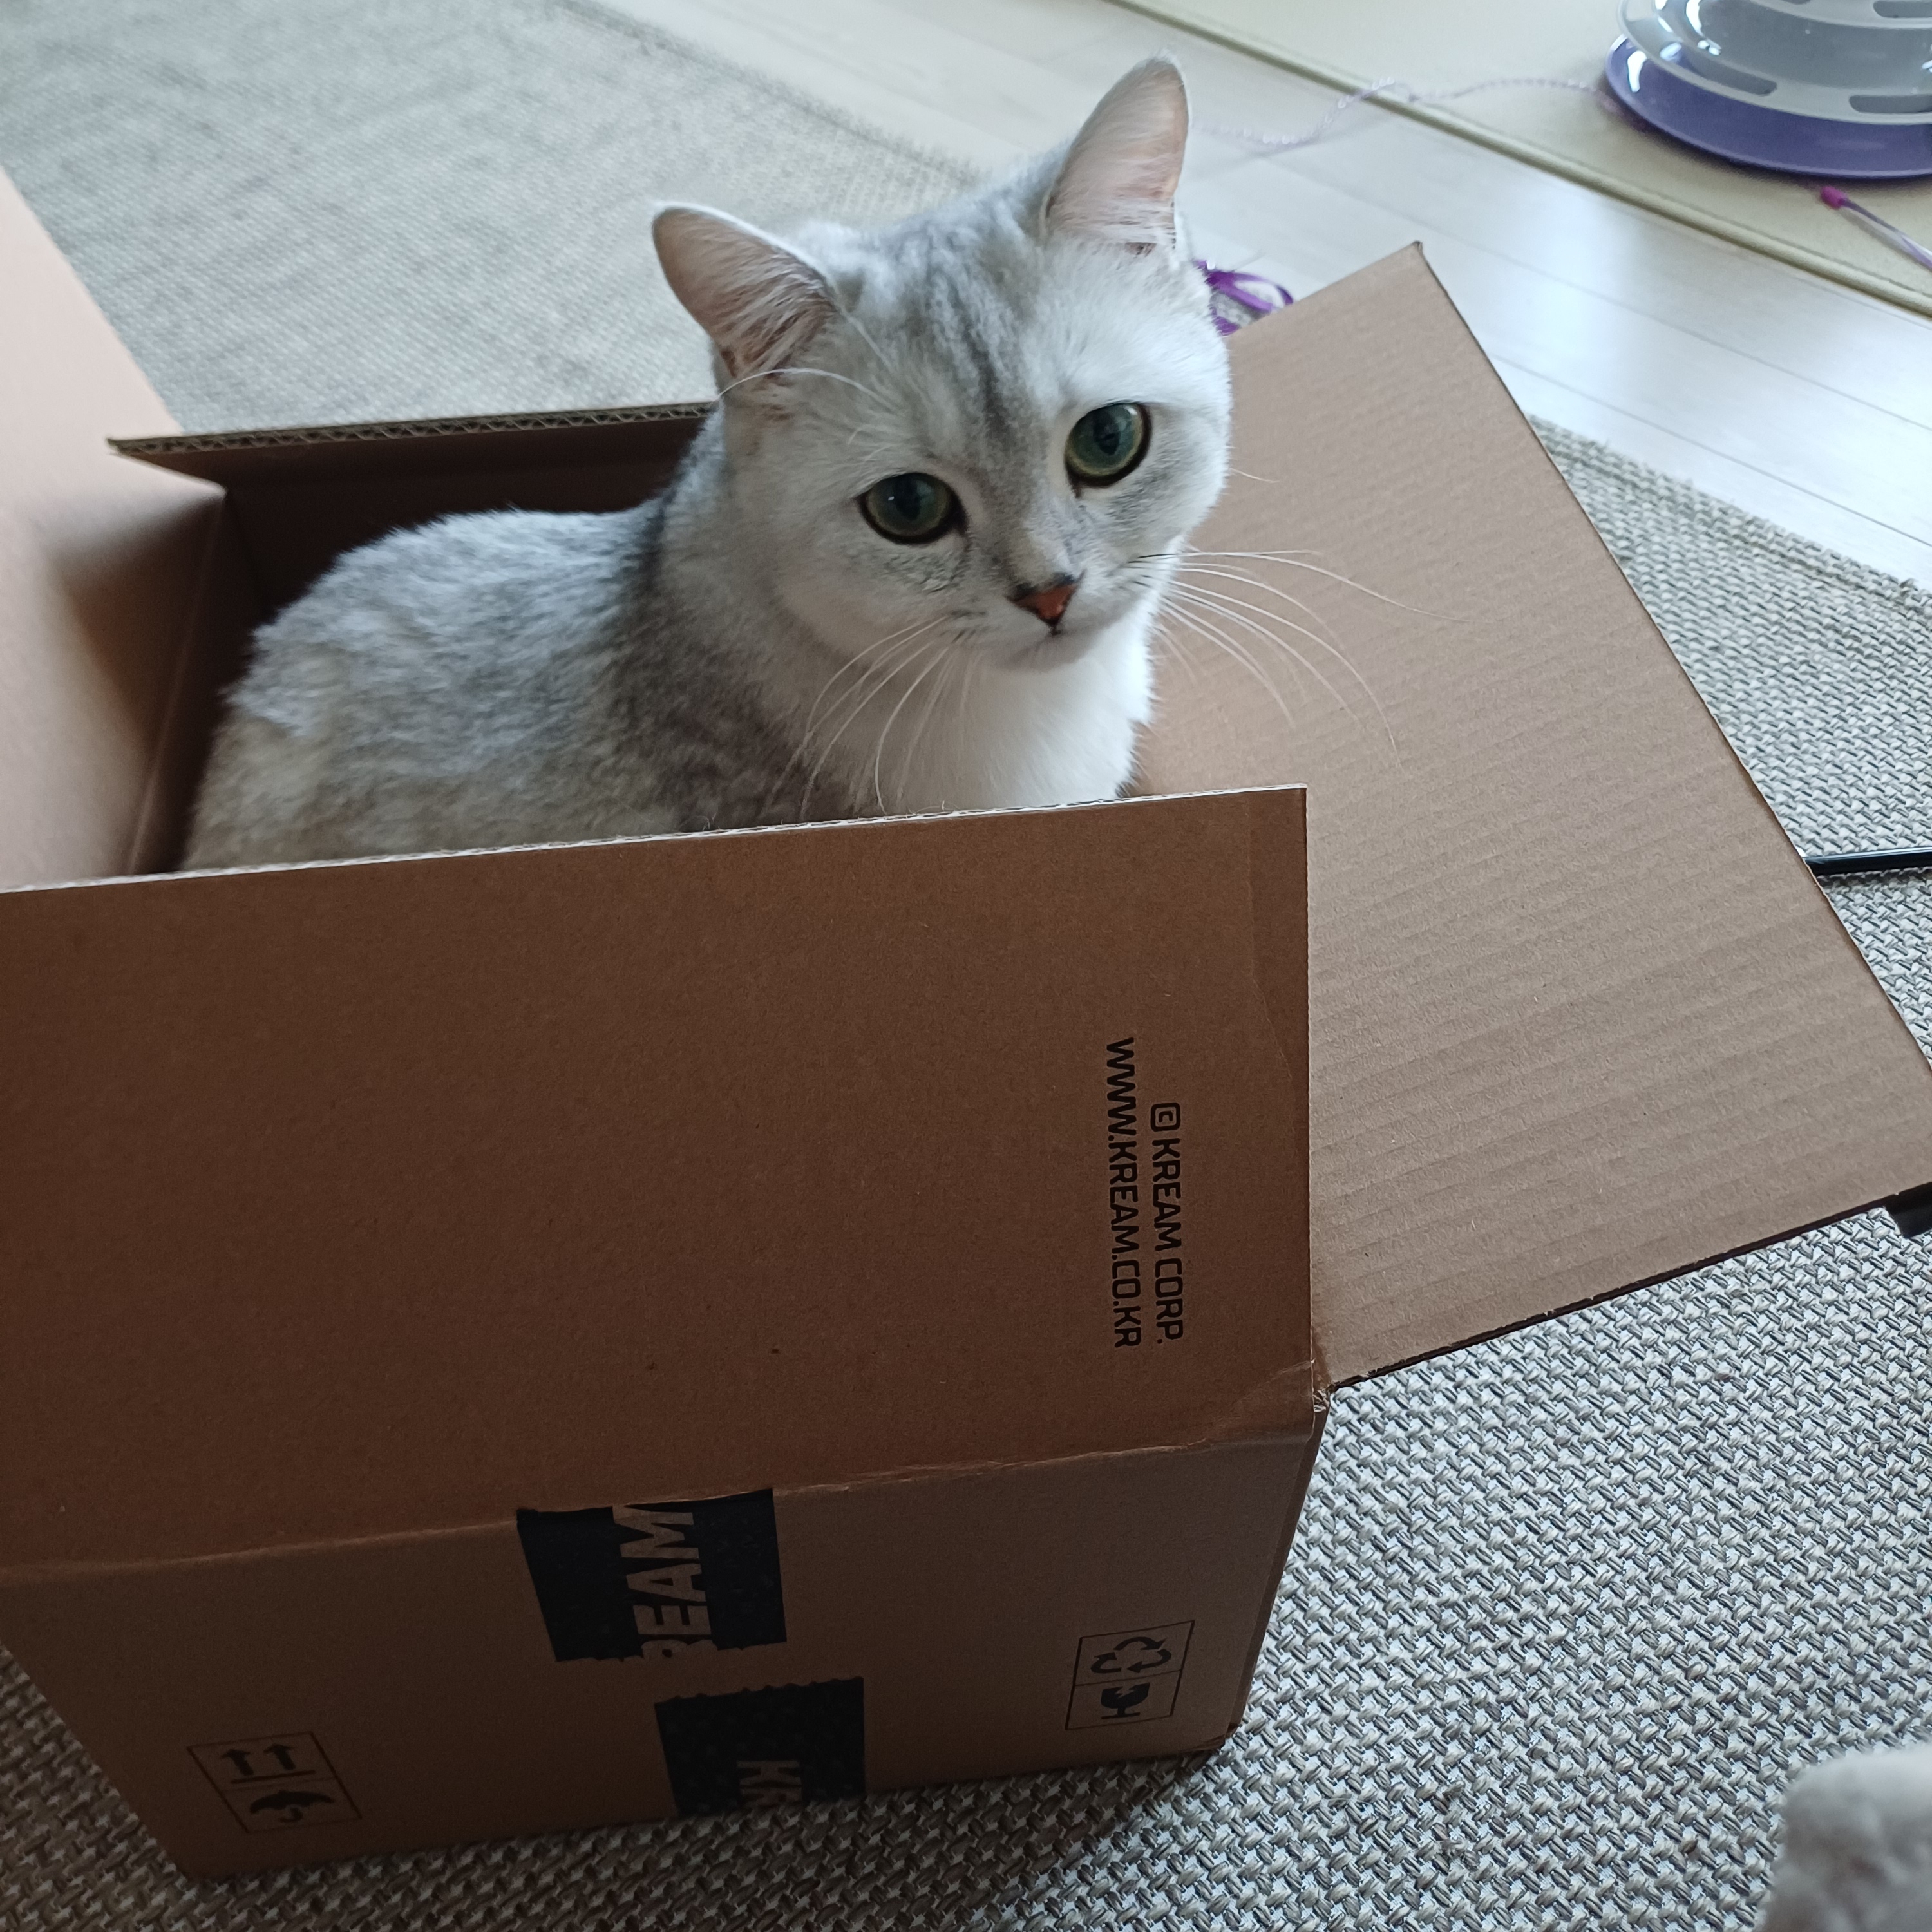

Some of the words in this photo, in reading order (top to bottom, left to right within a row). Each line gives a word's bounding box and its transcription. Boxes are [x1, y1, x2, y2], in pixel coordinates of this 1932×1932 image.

[1106, 1036, 1142, 1349] WWW.KREAM.CO.KR
[1151, 1137, 1182, 1252] KREAM
[1154, 1257, 1184, 1345] CORP.
